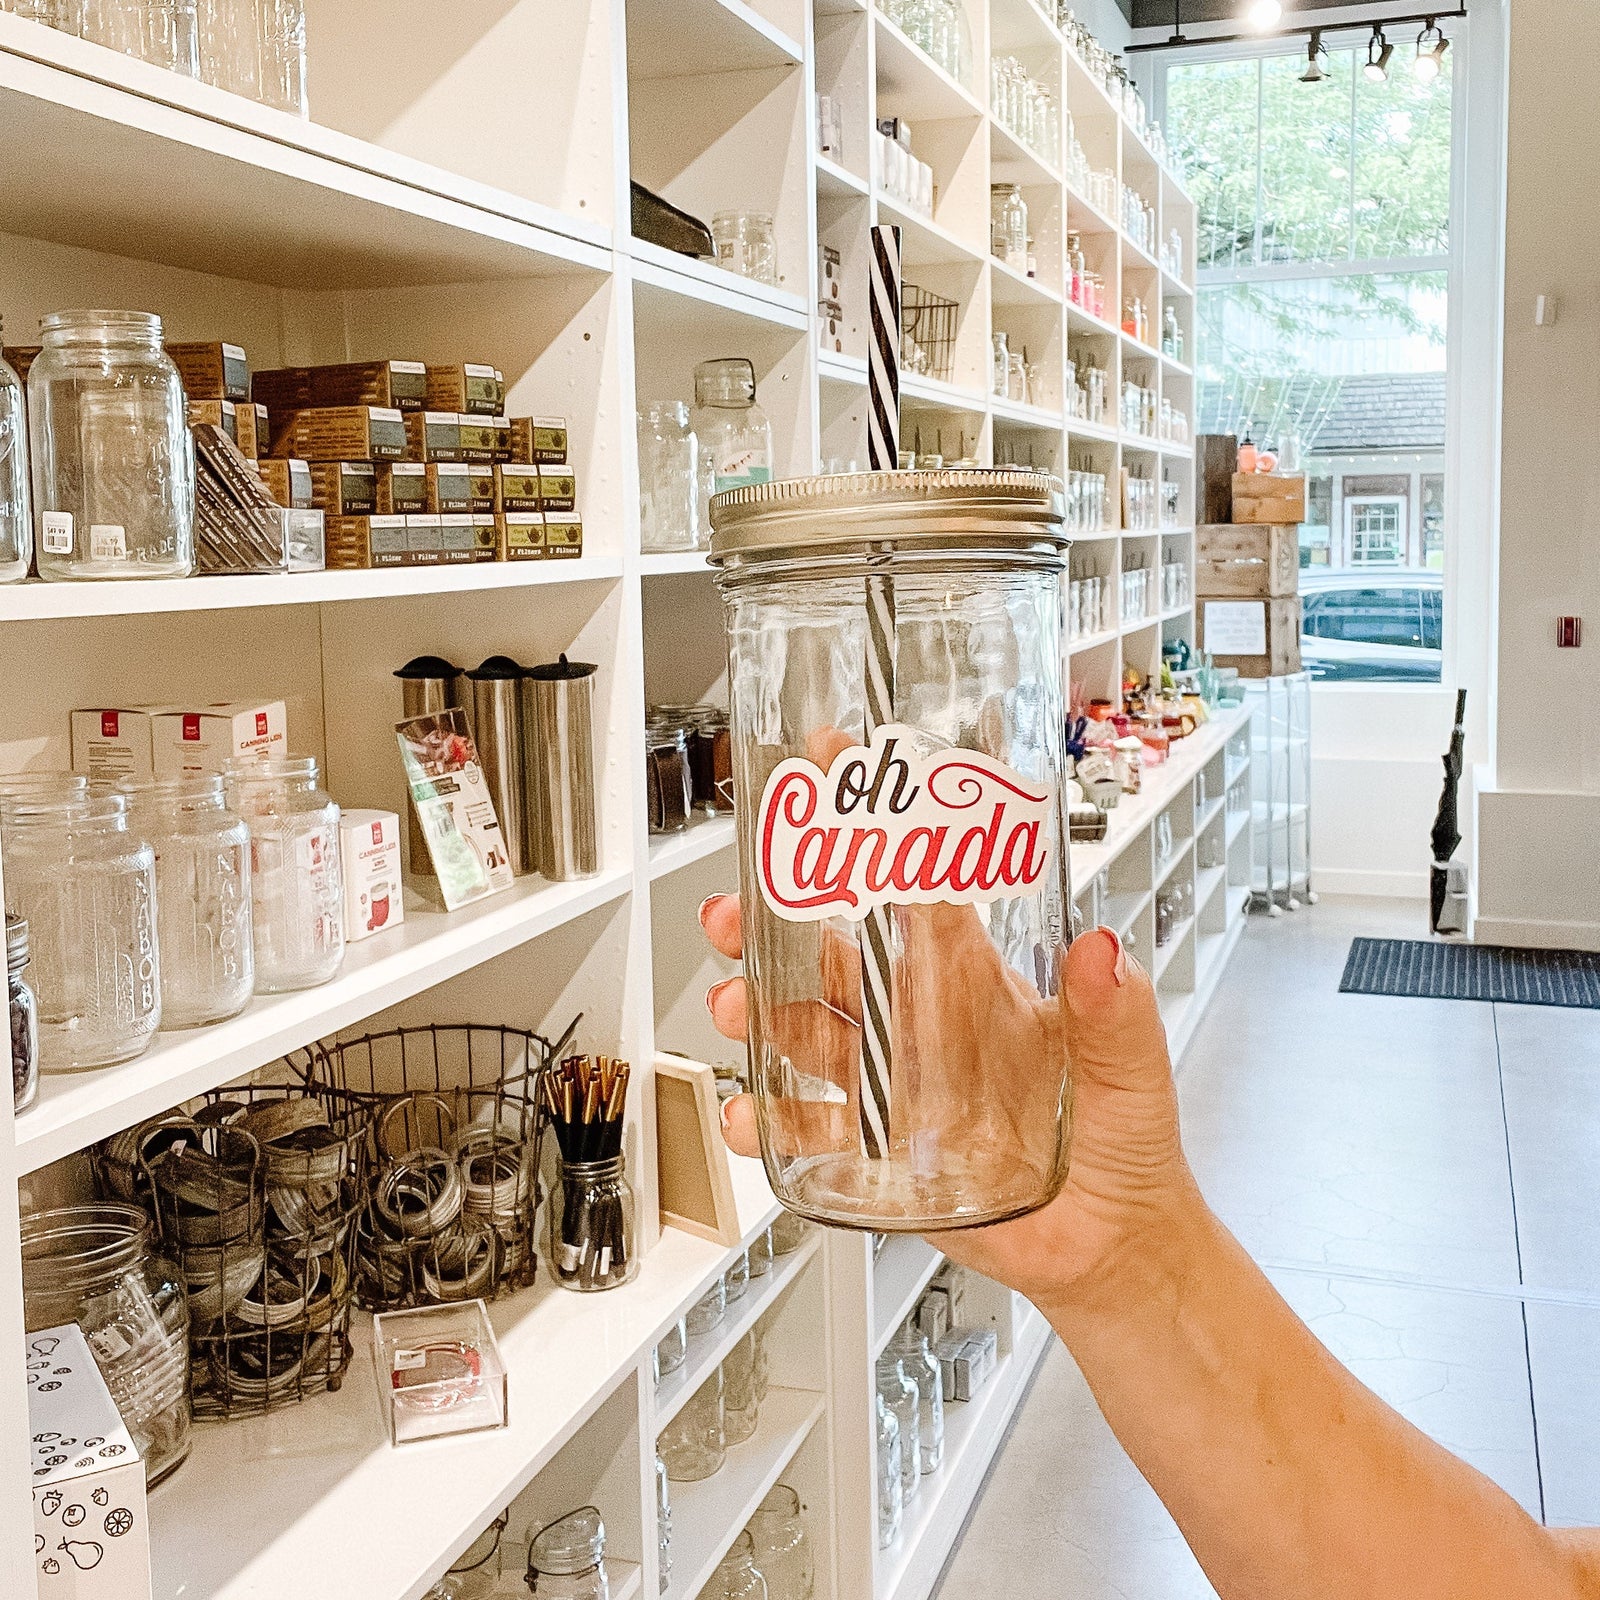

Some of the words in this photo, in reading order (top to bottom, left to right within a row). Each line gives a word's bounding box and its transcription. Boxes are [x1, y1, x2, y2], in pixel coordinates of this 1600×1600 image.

[419, 552, 439, 560] Filter
[835, 738, 920, 815] oh
[762, 771, 1048, 908] Canada
